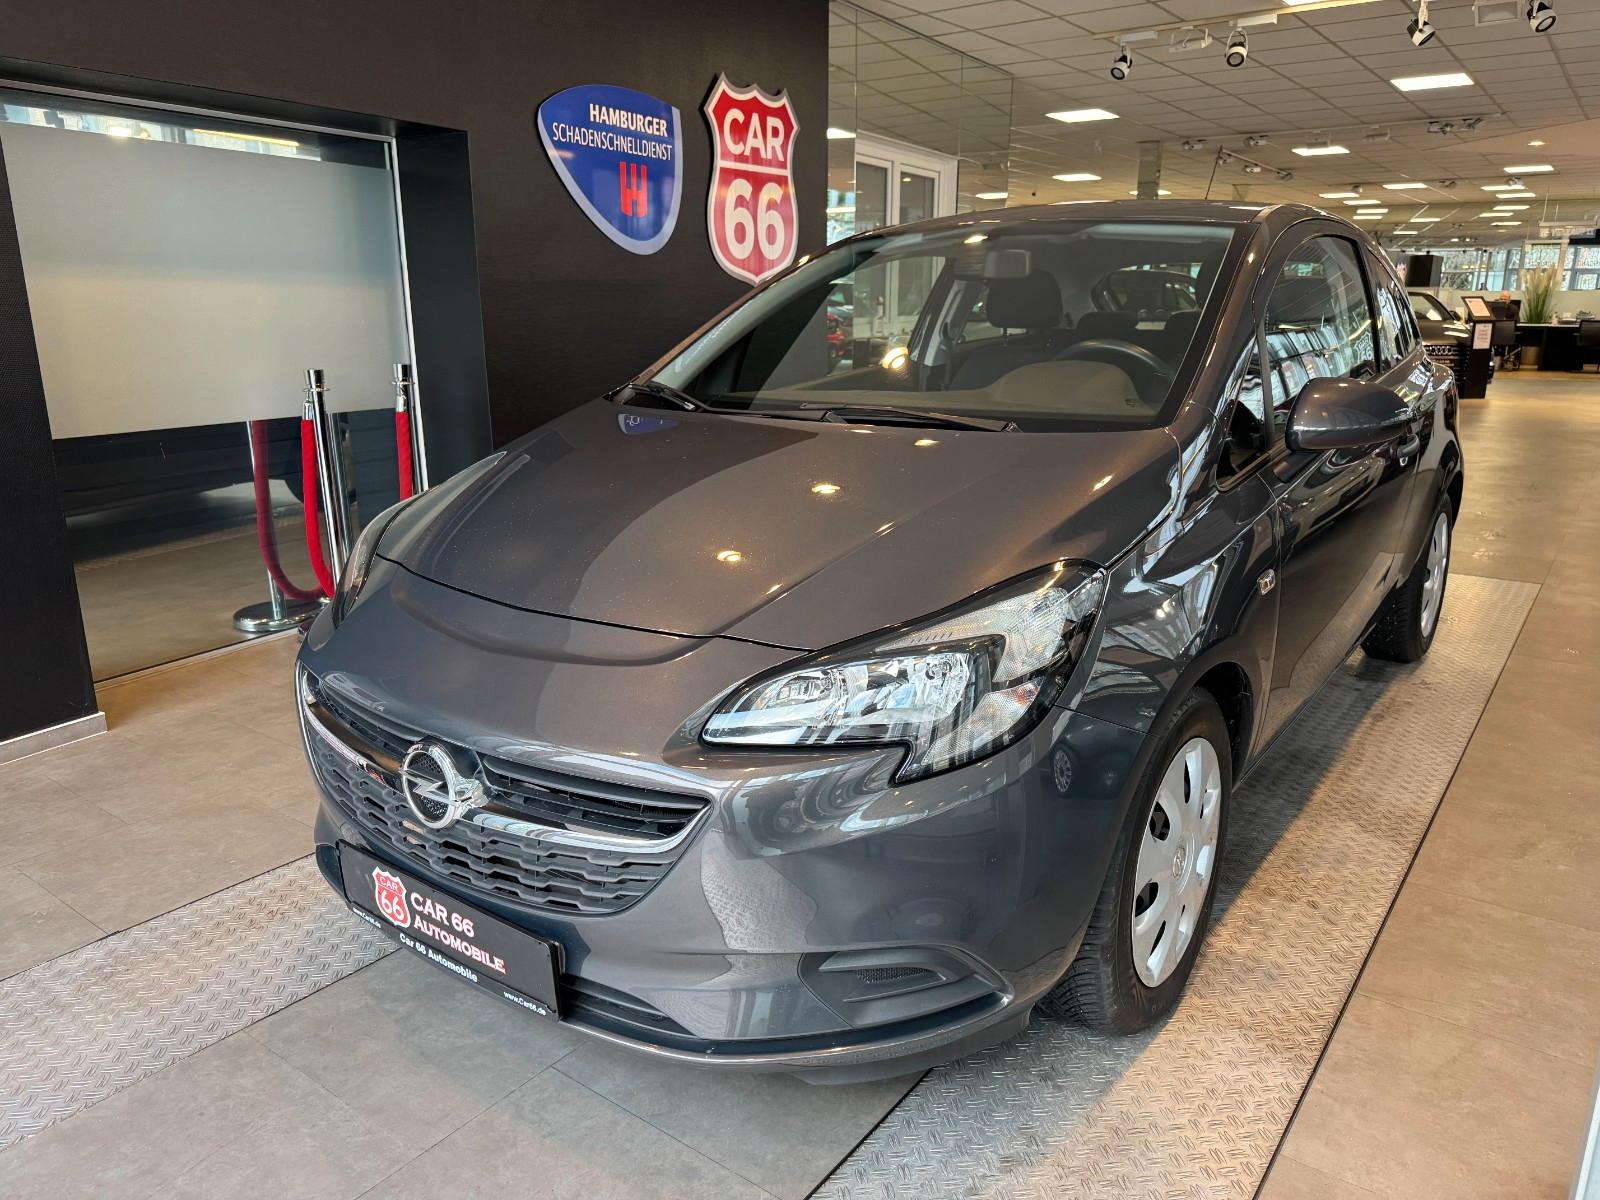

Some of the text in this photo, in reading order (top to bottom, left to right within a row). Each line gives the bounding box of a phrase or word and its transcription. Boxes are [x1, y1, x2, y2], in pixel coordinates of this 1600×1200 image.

[552, 122, 672, 161] SCHADENSCHNELLDIENST
[589, 103, 668, 138] HAMBURGER
[723, 108, 785, 162] CAR
[724, 178, 784, 260] 66
[380, 877, 399, 892] CAR
[381, 890, 405, 921] 66
[411, 892, 475, 938] CAR 66
[400, 932, 415, 948] Car
[428, 949, 479, 983] Automobile
[414, 914, 507, 975] AUTOMOBILE
